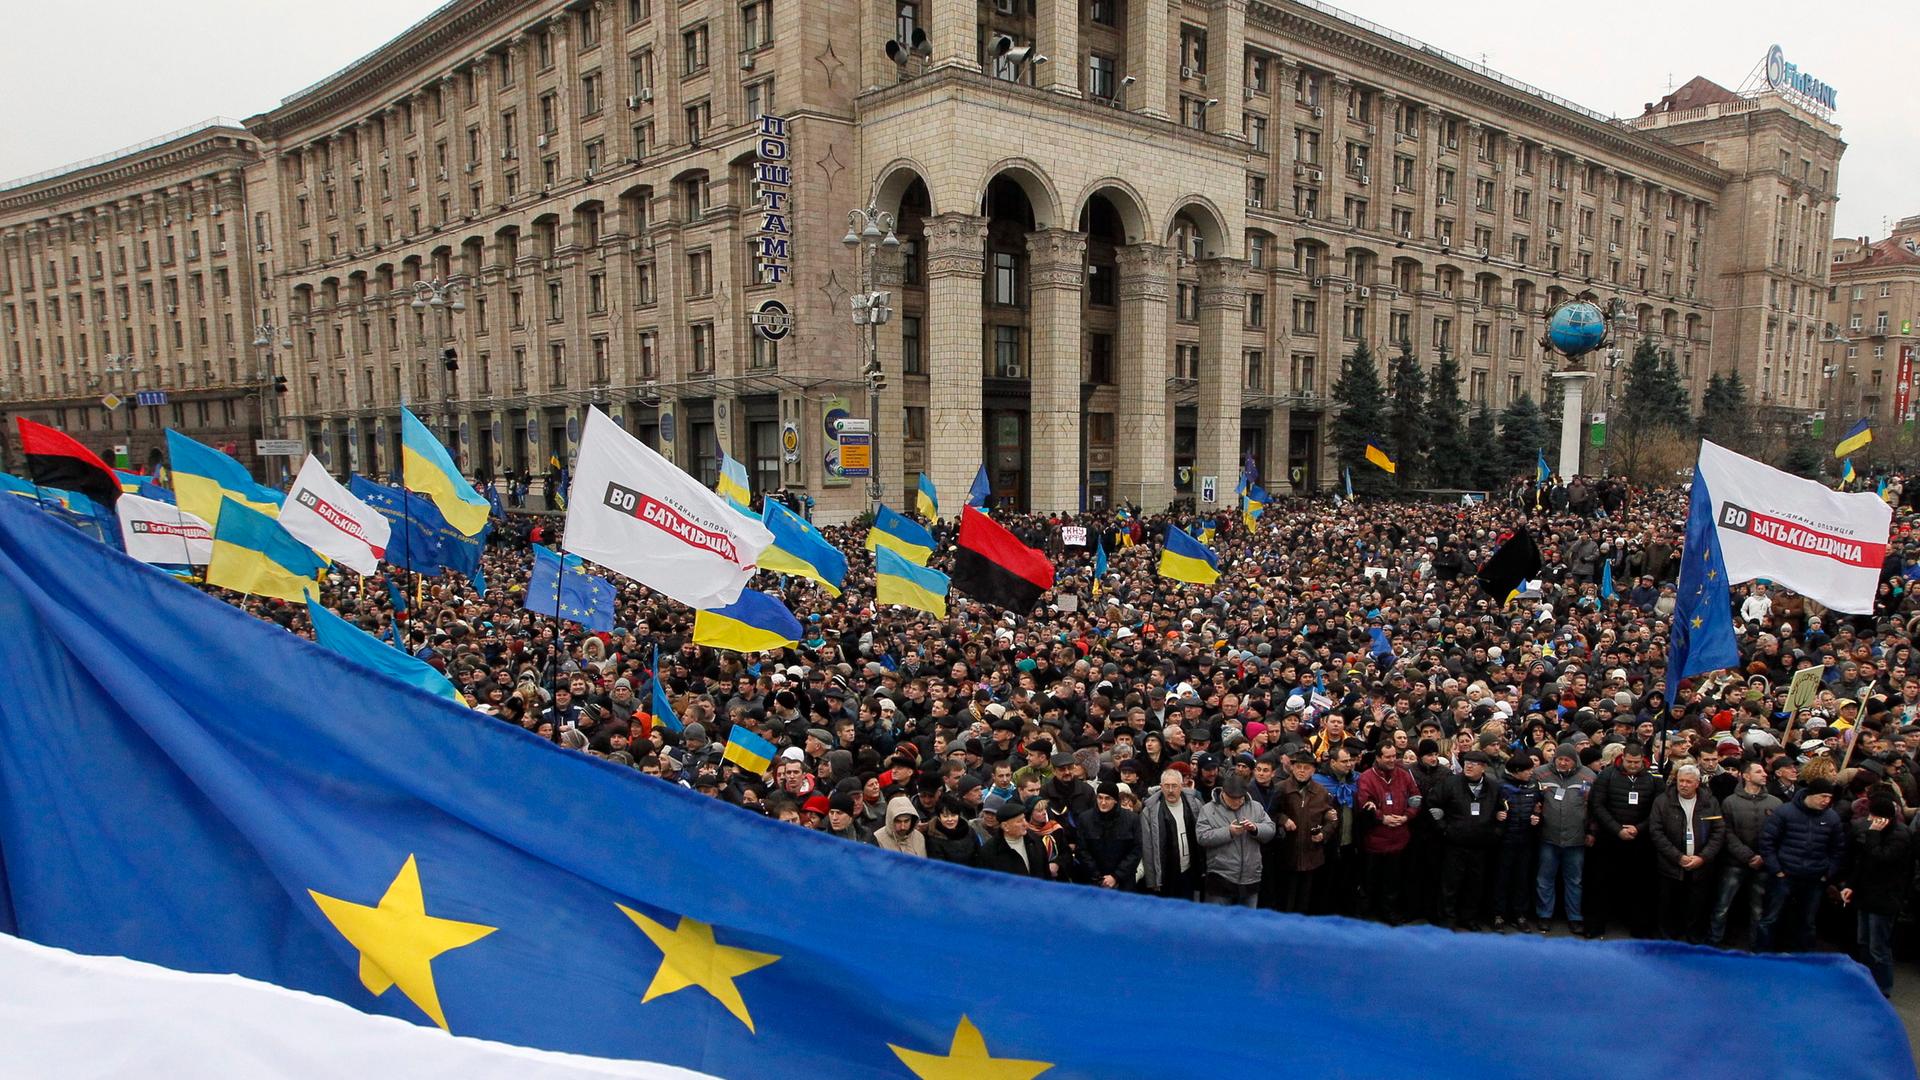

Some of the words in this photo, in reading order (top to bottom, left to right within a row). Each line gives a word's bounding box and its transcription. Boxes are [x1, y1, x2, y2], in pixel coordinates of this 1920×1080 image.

[1785, 62, 1838, 111] FinBANK
[758, 114, 790, 284] ПОШТАМТ
[133, 522, 148, 532] ВО
[300, 491, 317, 507] ВО
[318, 503, 368, 540] БАТЬКІВЩ
[609, 488, 637, 511] ВО
[643, 501, 737, 560] БАТЬКІВЩИ
[1724, 507, 1748, 528] ВО
[1753, 517, 1863, 563] БАТЬКІВЩИНА
